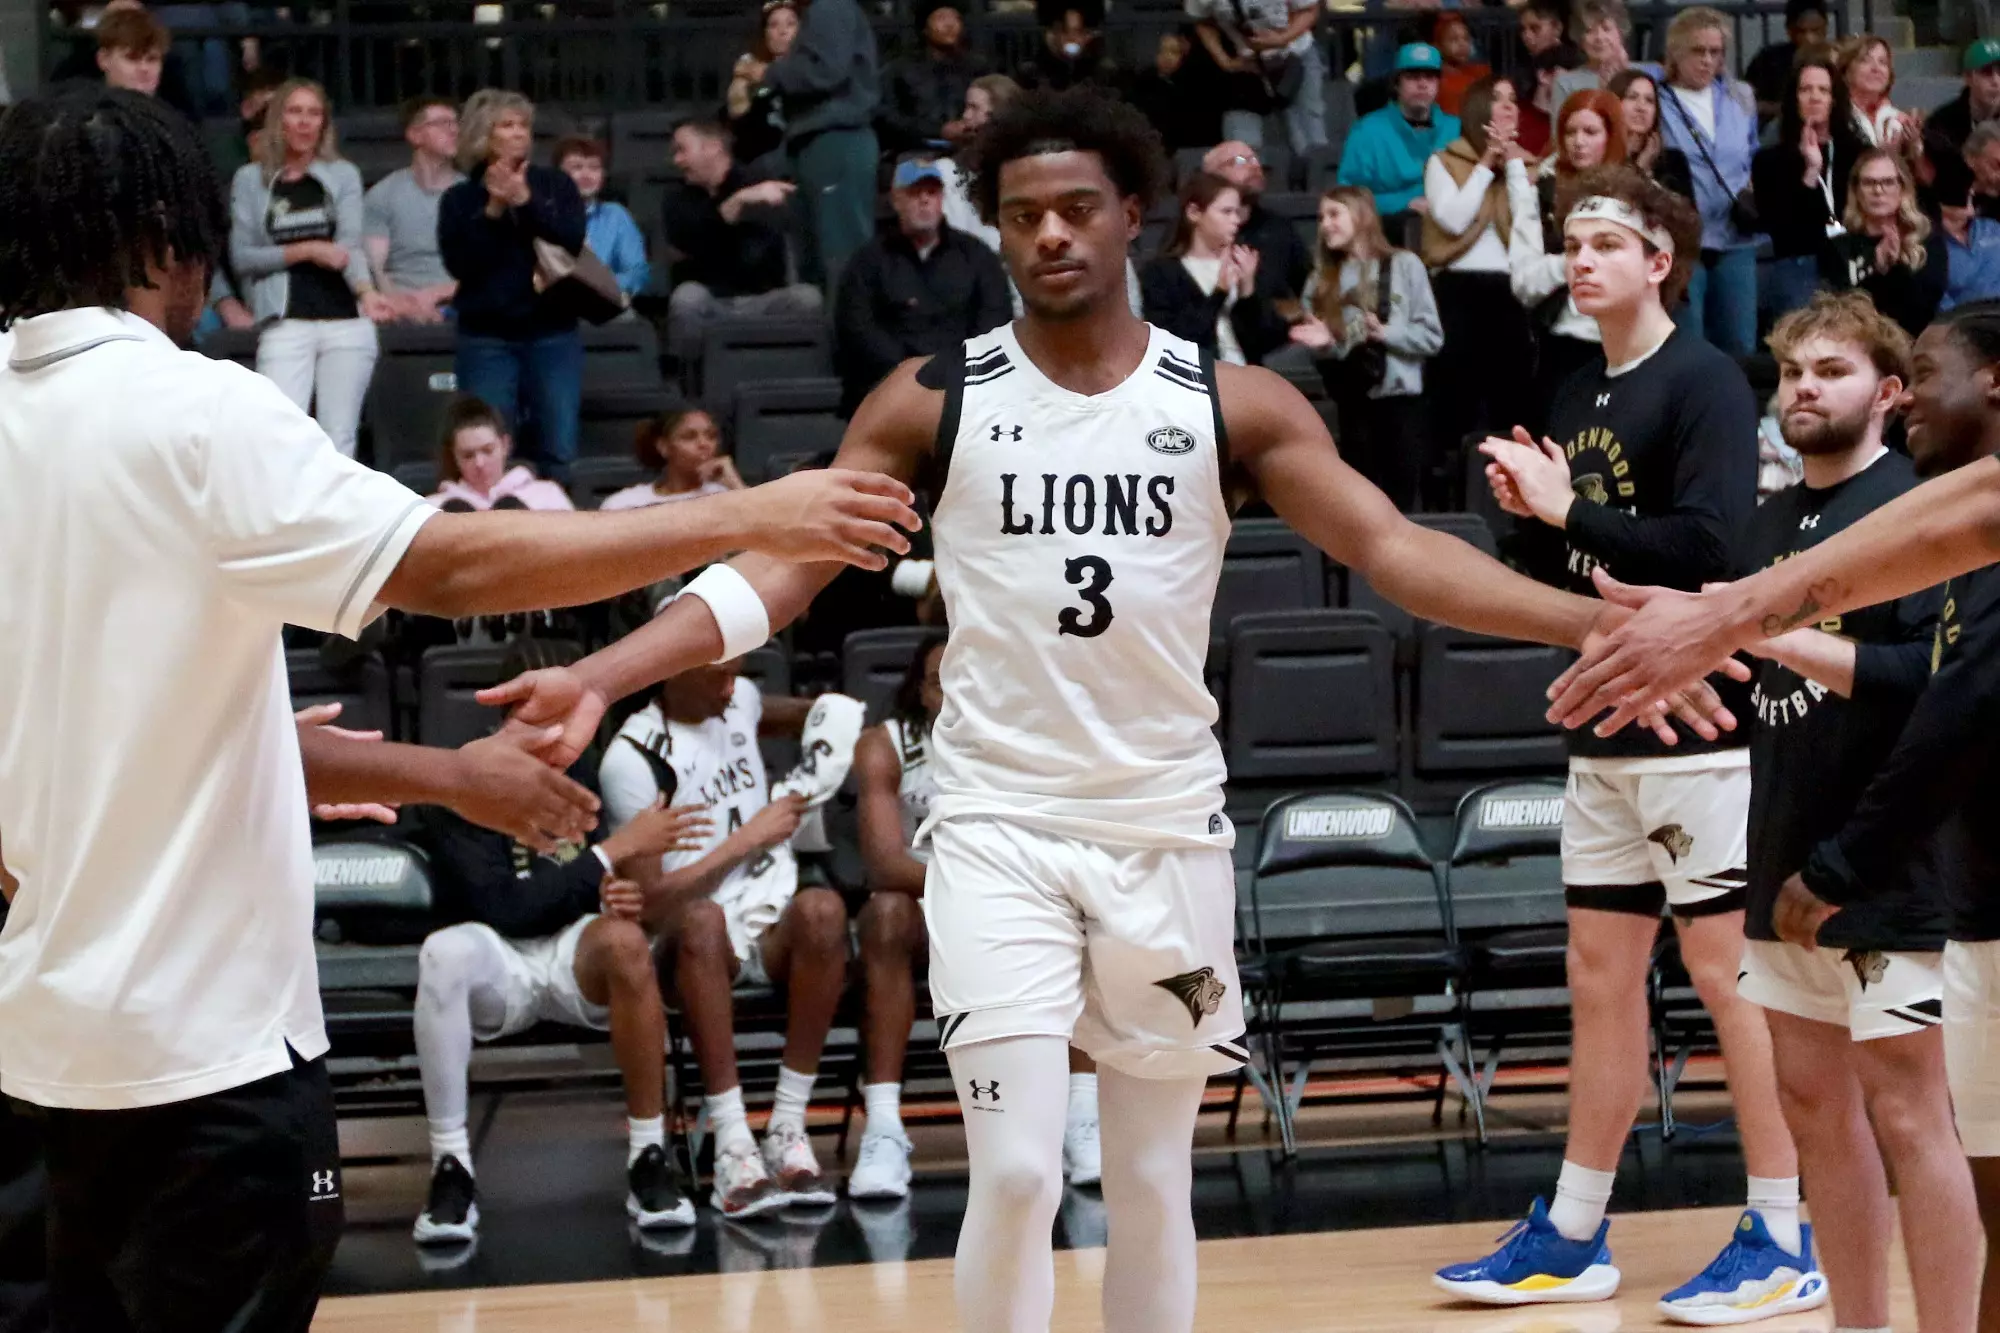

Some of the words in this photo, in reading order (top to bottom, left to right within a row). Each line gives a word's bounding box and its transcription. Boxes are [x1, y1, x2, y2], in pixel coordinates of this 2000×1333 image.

[1566, 426, 1636, 497] DENWOOD
[999, 473, 1175, 537] LIONS
[1057, 554, 1115, 638] 3
[1750, 678, 1829, 726] SKETBA
[1288, 807, 1392, 837] LINDENWOOD
[1483, 798, 1565, 827] LINDENWO
